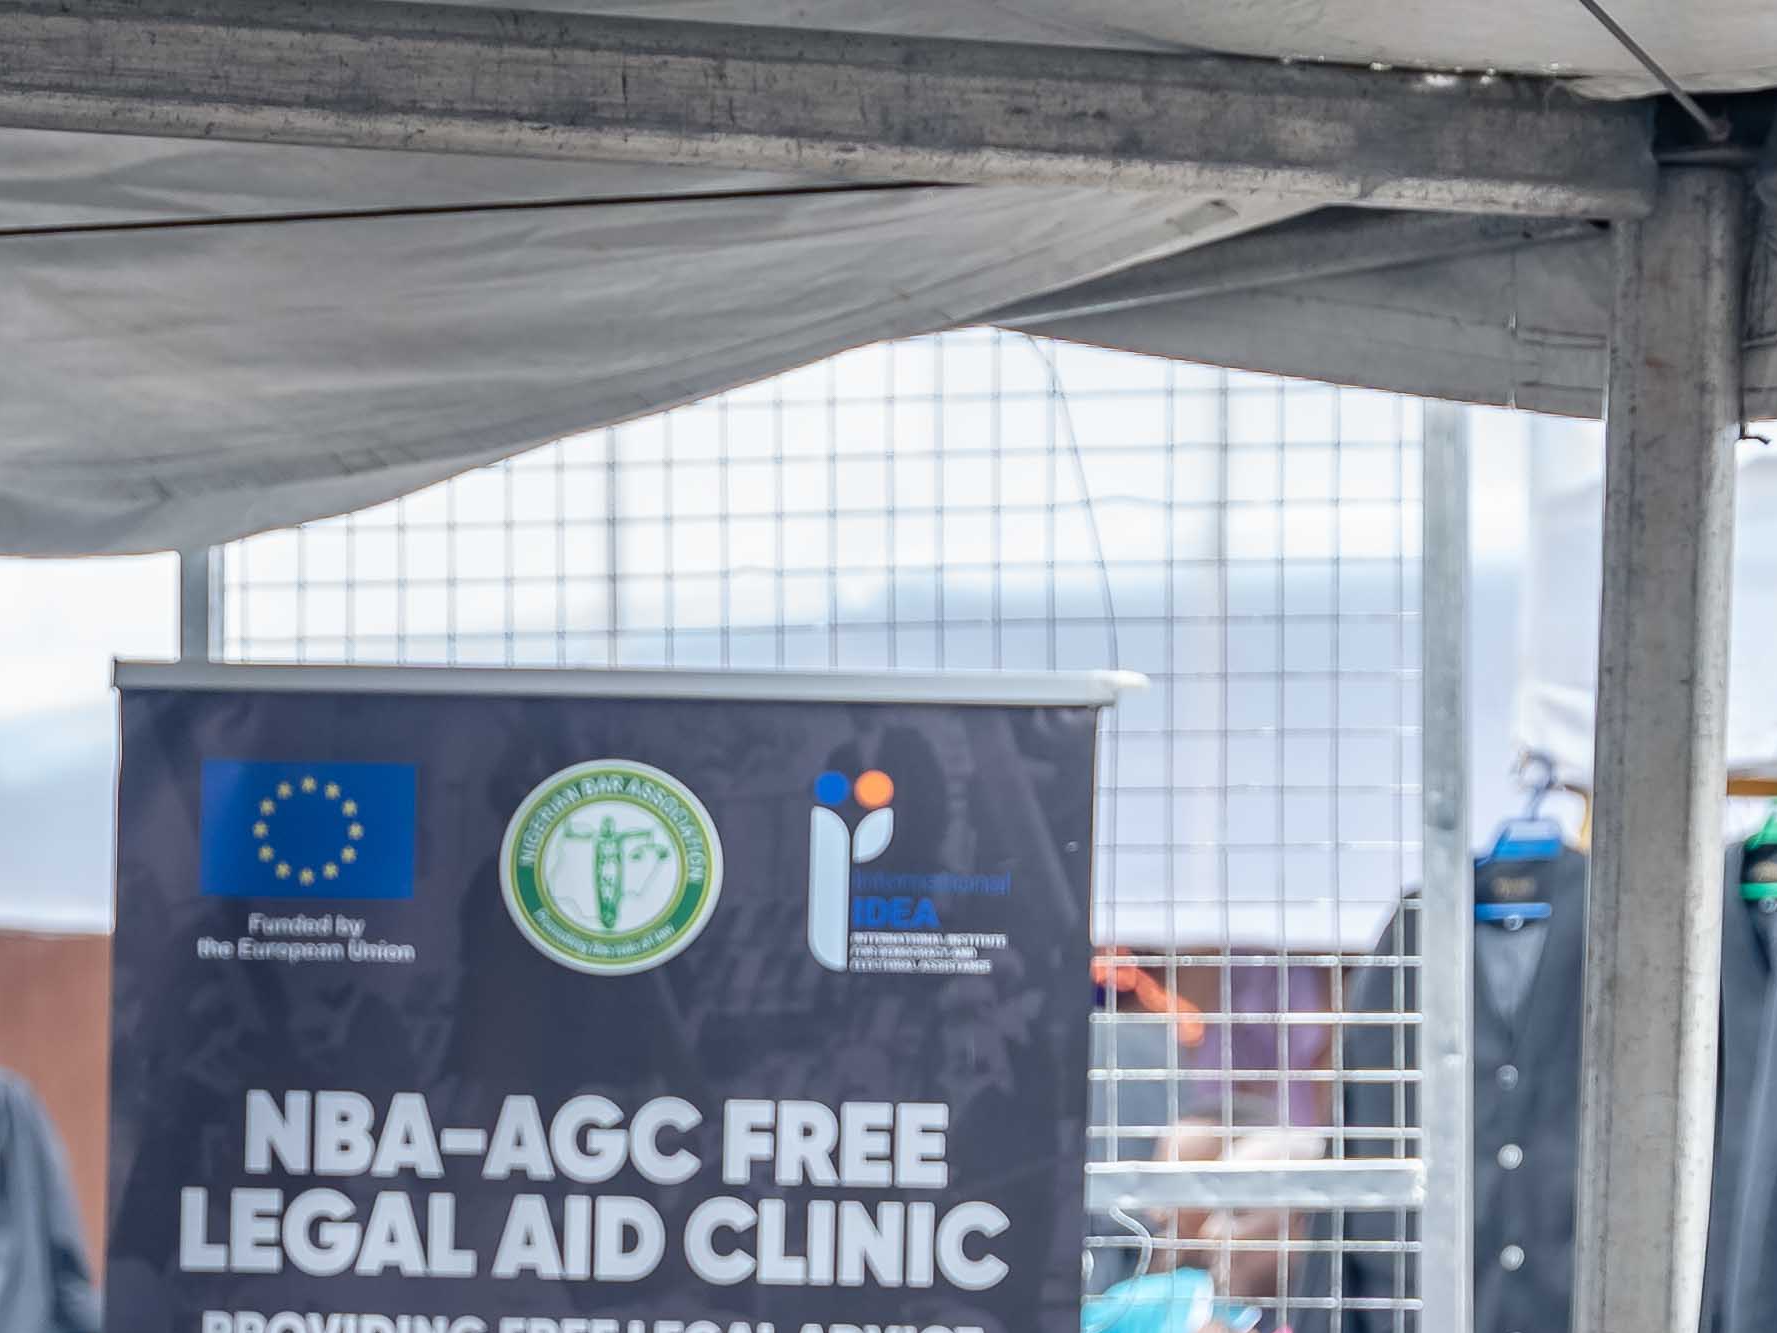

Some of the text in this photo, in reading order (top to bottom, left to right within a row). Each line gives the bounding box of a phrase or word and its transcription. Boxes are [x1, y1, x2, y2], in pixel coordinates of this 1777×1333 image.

[248, 913, 366, 939] Funded by
[853, 895, 942, 929] IDEA
[198, 937, 417, 965] the European Union
[244, 1089, 949, 1189] NBA-AGC FREE
[179, 1187, 1010, 1291] LEGAL AID CLINIC
